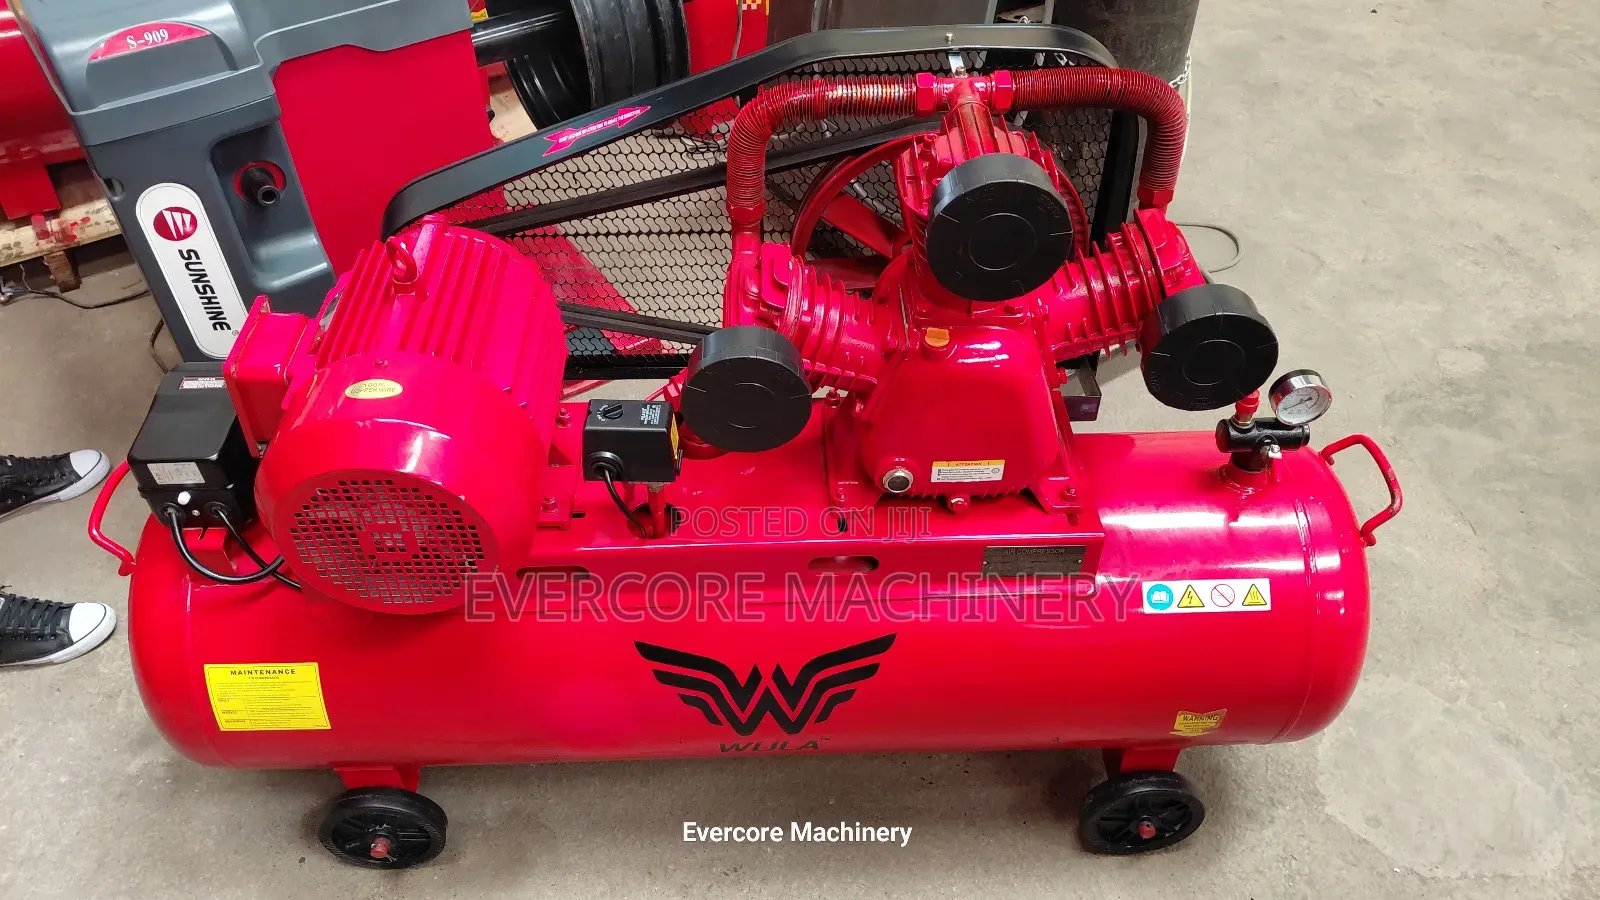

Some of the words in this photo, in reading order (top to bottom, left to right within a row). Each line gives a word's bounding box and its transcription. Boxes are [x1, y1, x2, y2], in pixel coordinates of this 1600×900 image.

[126, 28, 169, 49] S-909
[177, 248, 232, 331] SUNSHINE
[720, 740, 820, 752] WULA
